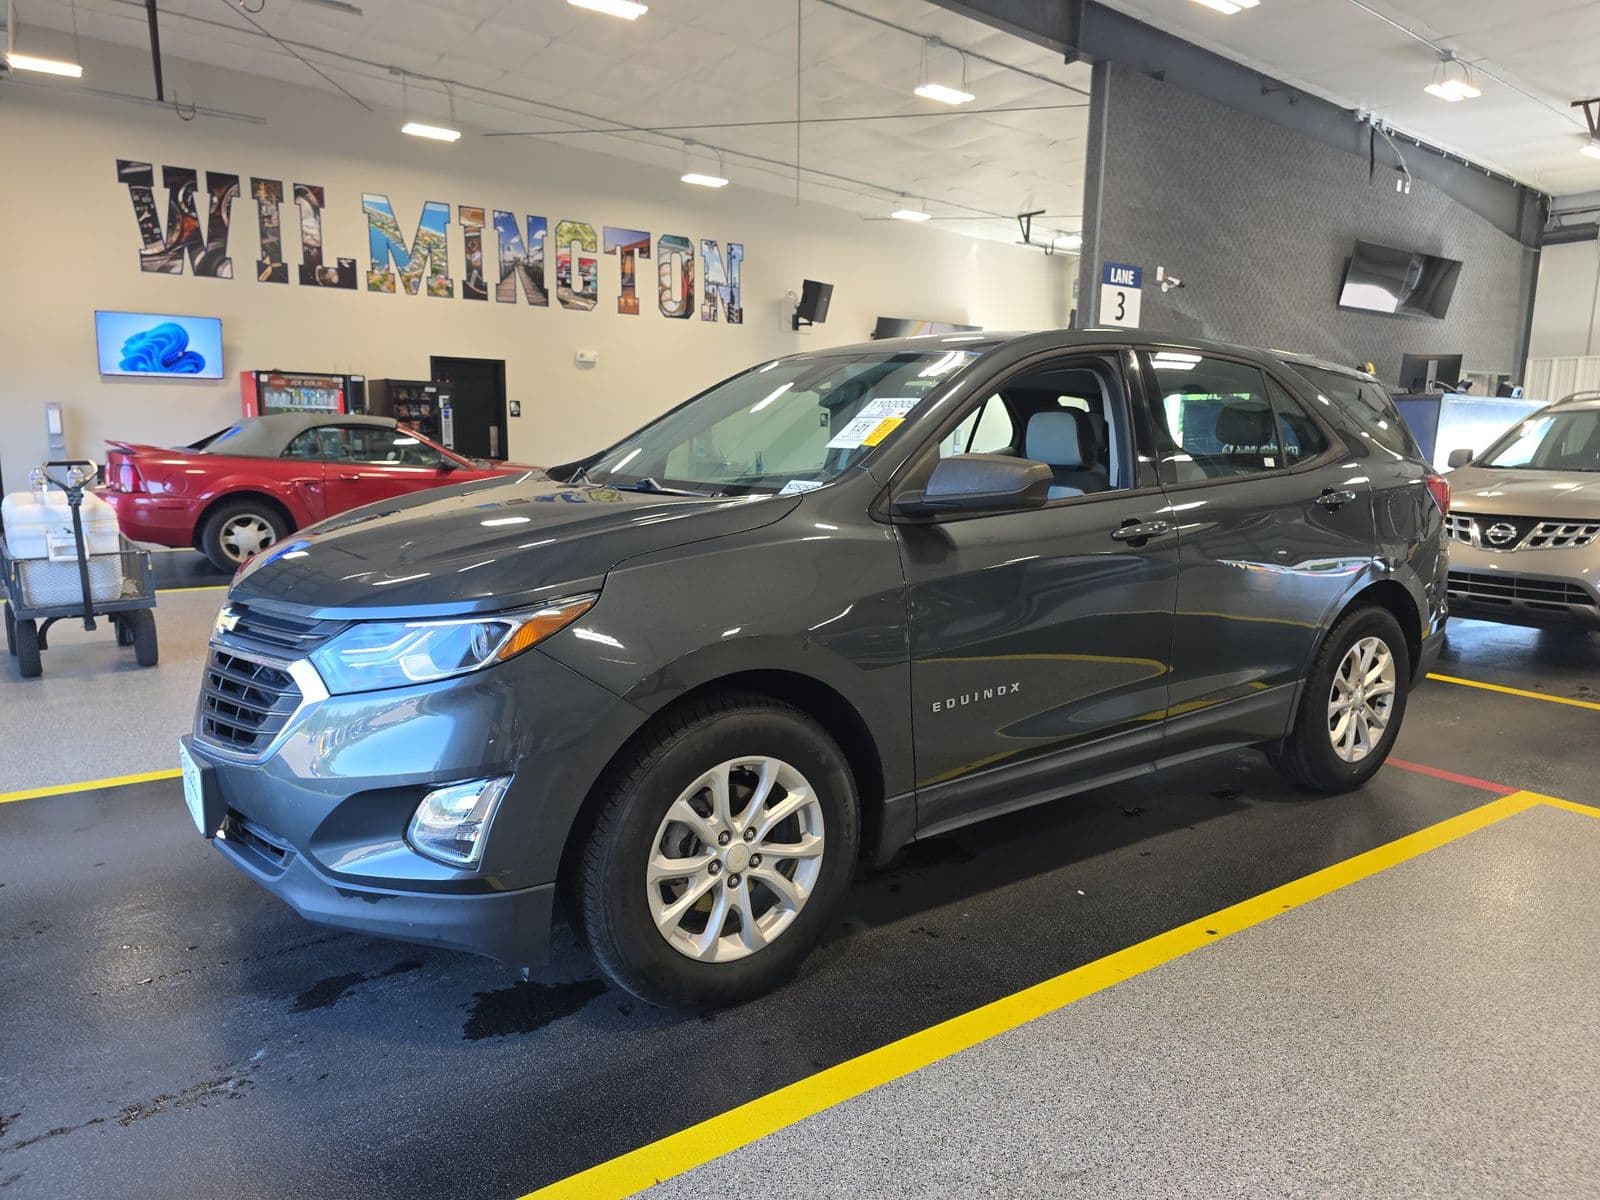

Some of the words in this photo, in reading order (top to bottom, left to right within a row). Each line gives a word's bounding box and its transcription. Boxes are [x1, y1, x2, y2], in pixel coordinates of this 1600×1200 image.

[117, 160, 744, 325] WILMINGTON
[1110, 267, 1135, 286] LANE
[1115, 291, 1126, 321] 3
[932, 682, 1020, 713] EQUINOX
